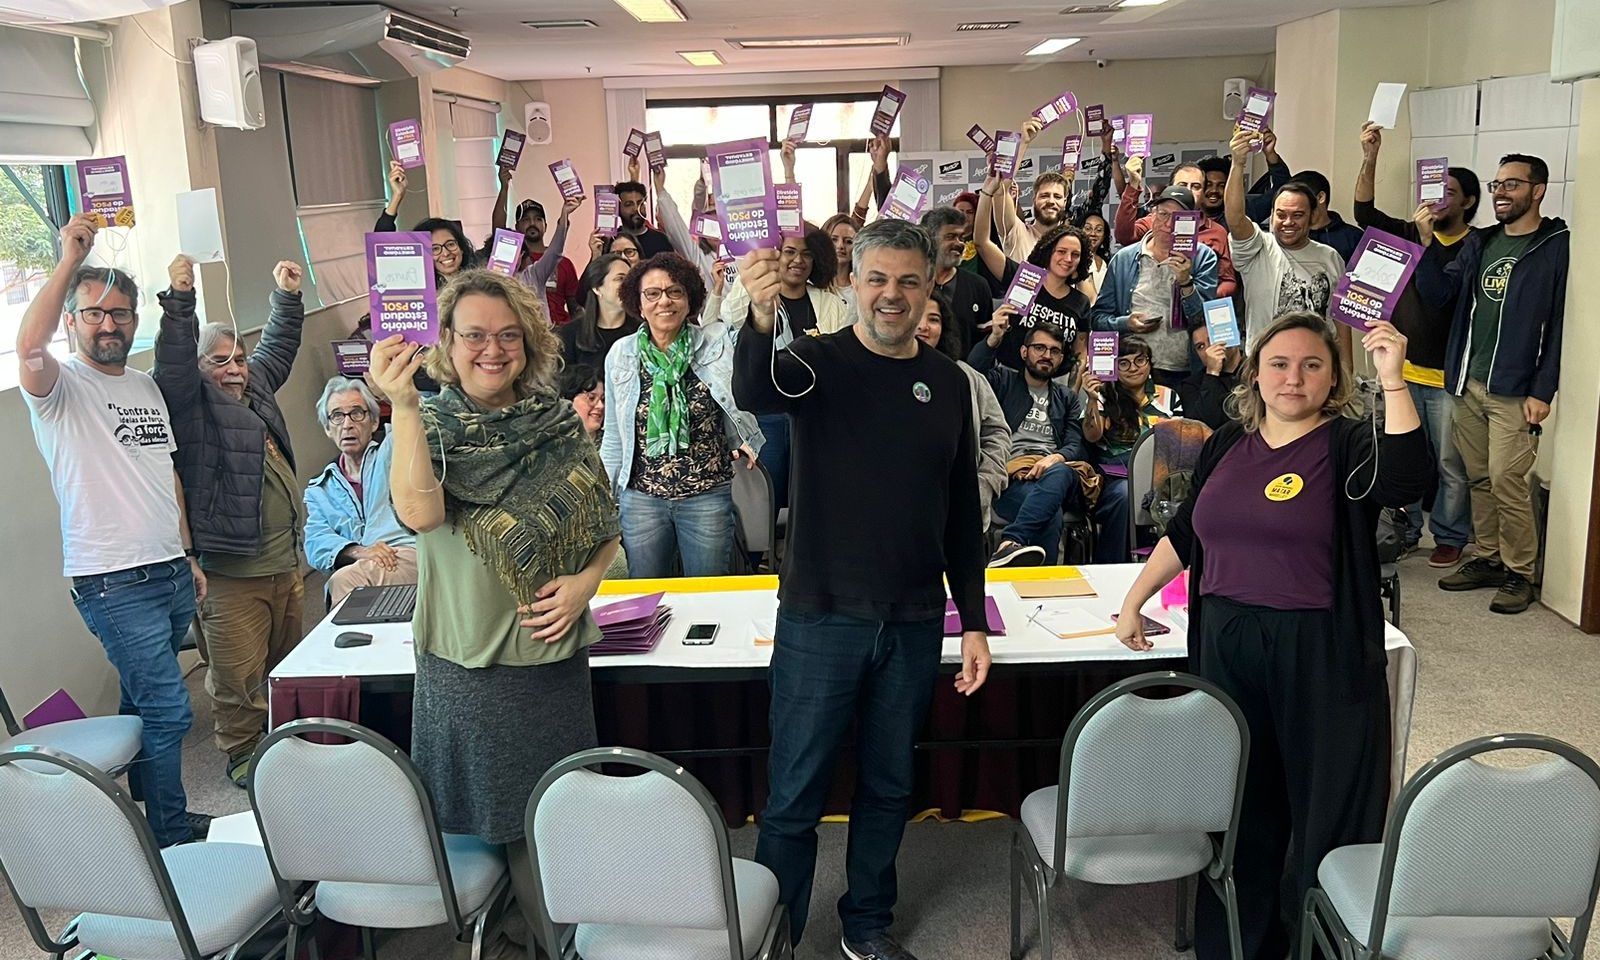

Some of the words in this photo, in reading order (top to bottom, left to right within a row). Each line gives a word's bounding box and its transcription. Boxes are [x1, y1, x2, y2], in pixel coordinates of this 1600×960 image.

[728, 211, 750, 221] PSOL
[752, 210, 764, 218] do
[727, 220, 768, 232] Estadual
[729, 229, 768, 242] Diretório
[1347, 290, 1370, 304] PSOL
[382, 303, 408, 311] PSOL
[1340, 298, 1381, 318] Estadual
[1370, 300, 1382, 308] do
[381, 312, 427, 321] Estadual
[1030, 303, 1076, 329] ESPEITA
[1339, 306, 1380, 320] iretório
[382, 322, 428, 332] Diretório
[1019, 316, 1036, 328] AS
